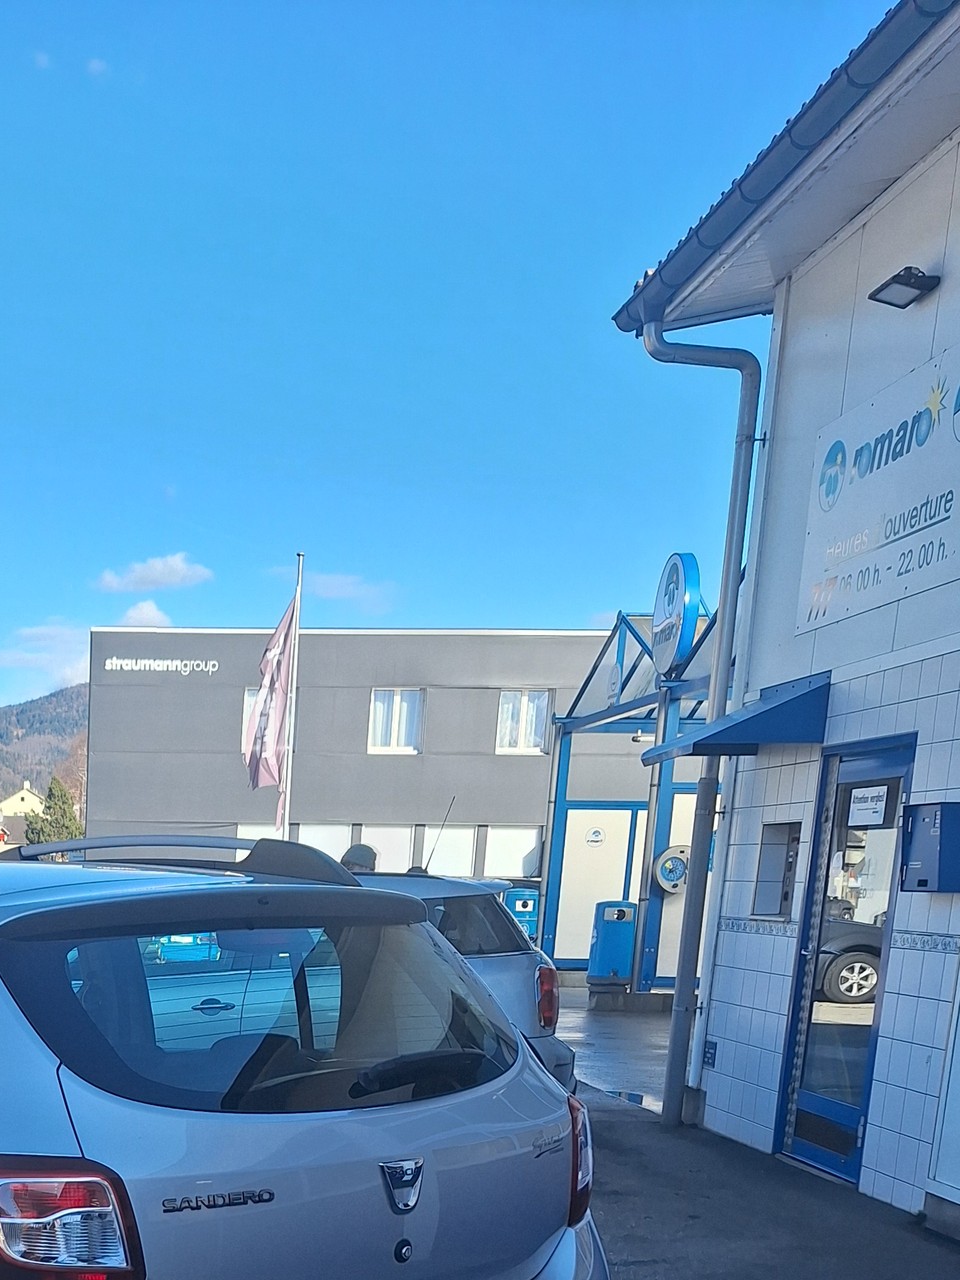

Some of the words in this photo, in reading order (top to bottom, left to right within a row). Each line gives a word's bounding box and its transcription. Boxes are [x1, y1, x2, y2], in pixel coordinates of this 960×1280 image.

[849, 407, 933, 485] romaro
[104, 656, 219, 676] straumanngroup
[161, 1188, 275, 1213] SANDERO
